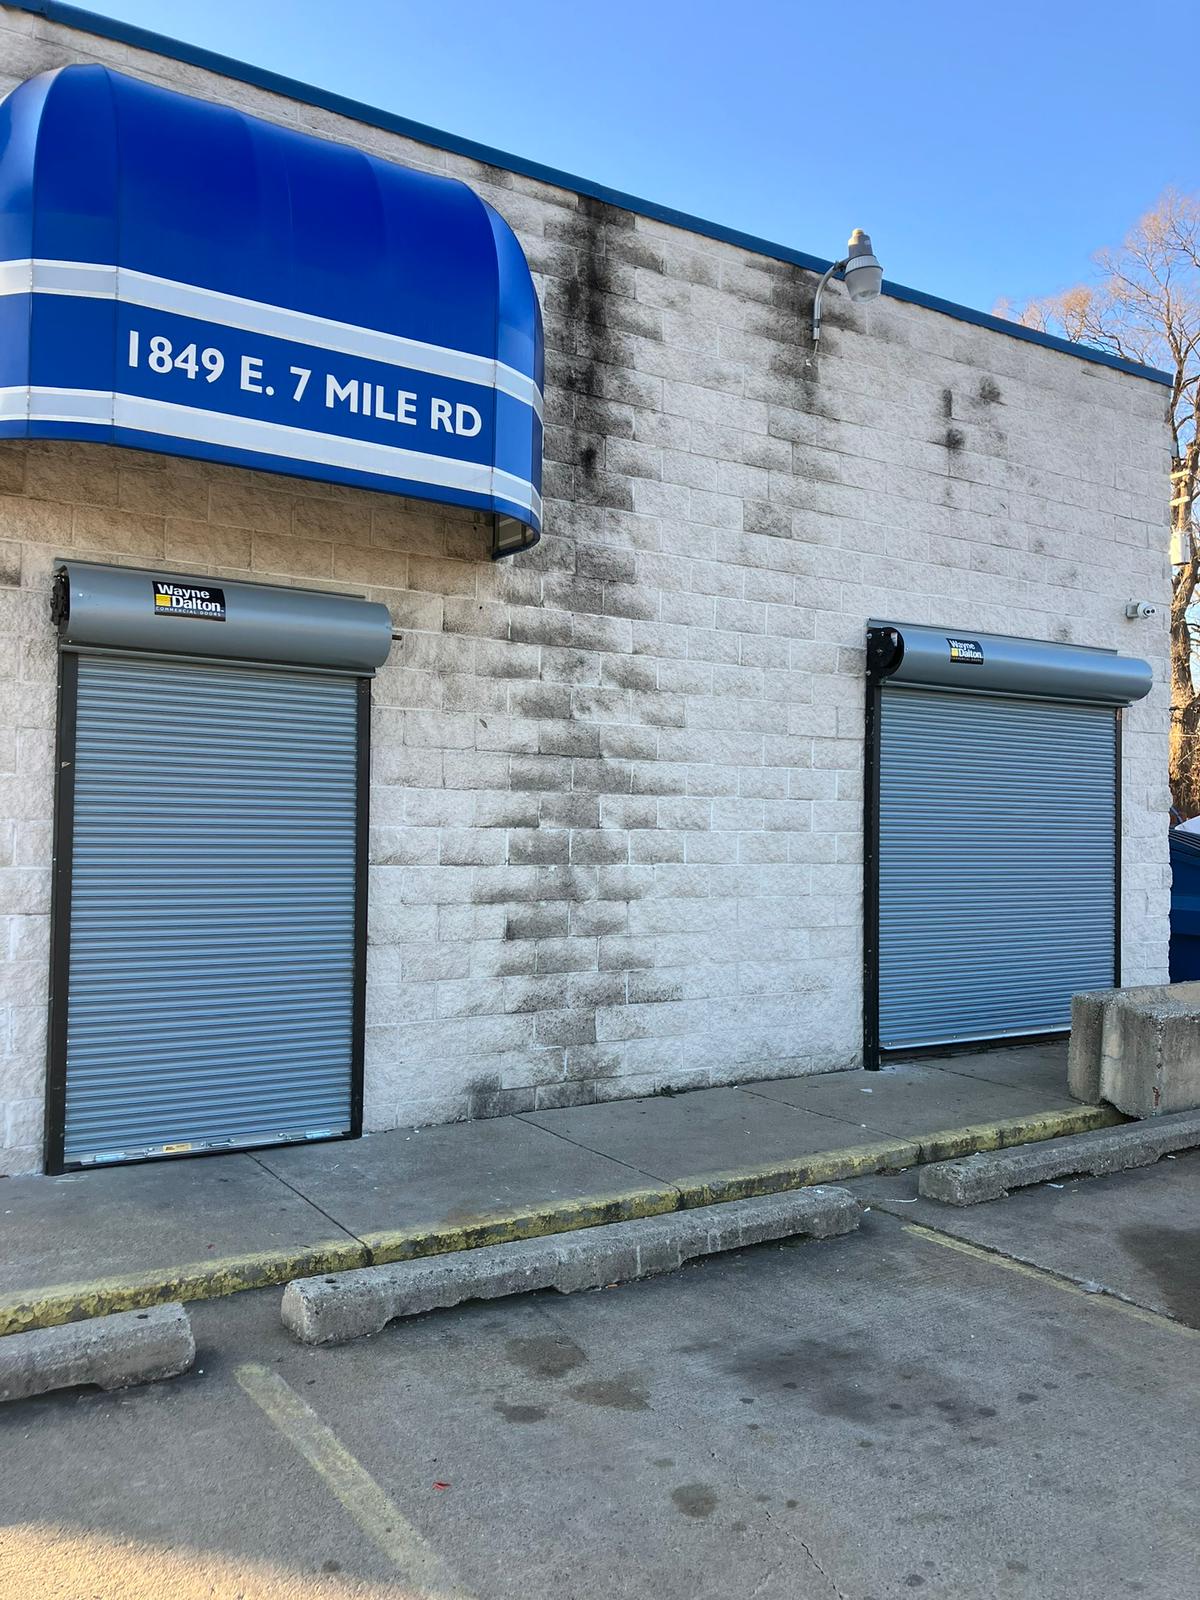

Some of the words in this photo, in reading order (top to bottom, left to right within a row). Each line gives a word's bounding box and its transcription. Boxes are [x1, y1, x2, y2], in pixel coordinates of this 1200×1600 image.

[128, 330, 225, 383] 1849
[240, 355, 274, 396] E.
[290, 366, 311, 402] 7
[325, 374, 417, 426] MILE
[430, 397, 482, 438] RD
[157, 583, 210, 599] Wayne
[156, 606, 197, 614] COMMERCIAL
[172, 595, 221, 612] Dalton
[949, 640, 975, 650] Wayne
[959, 649, 981, 658] Dalton
